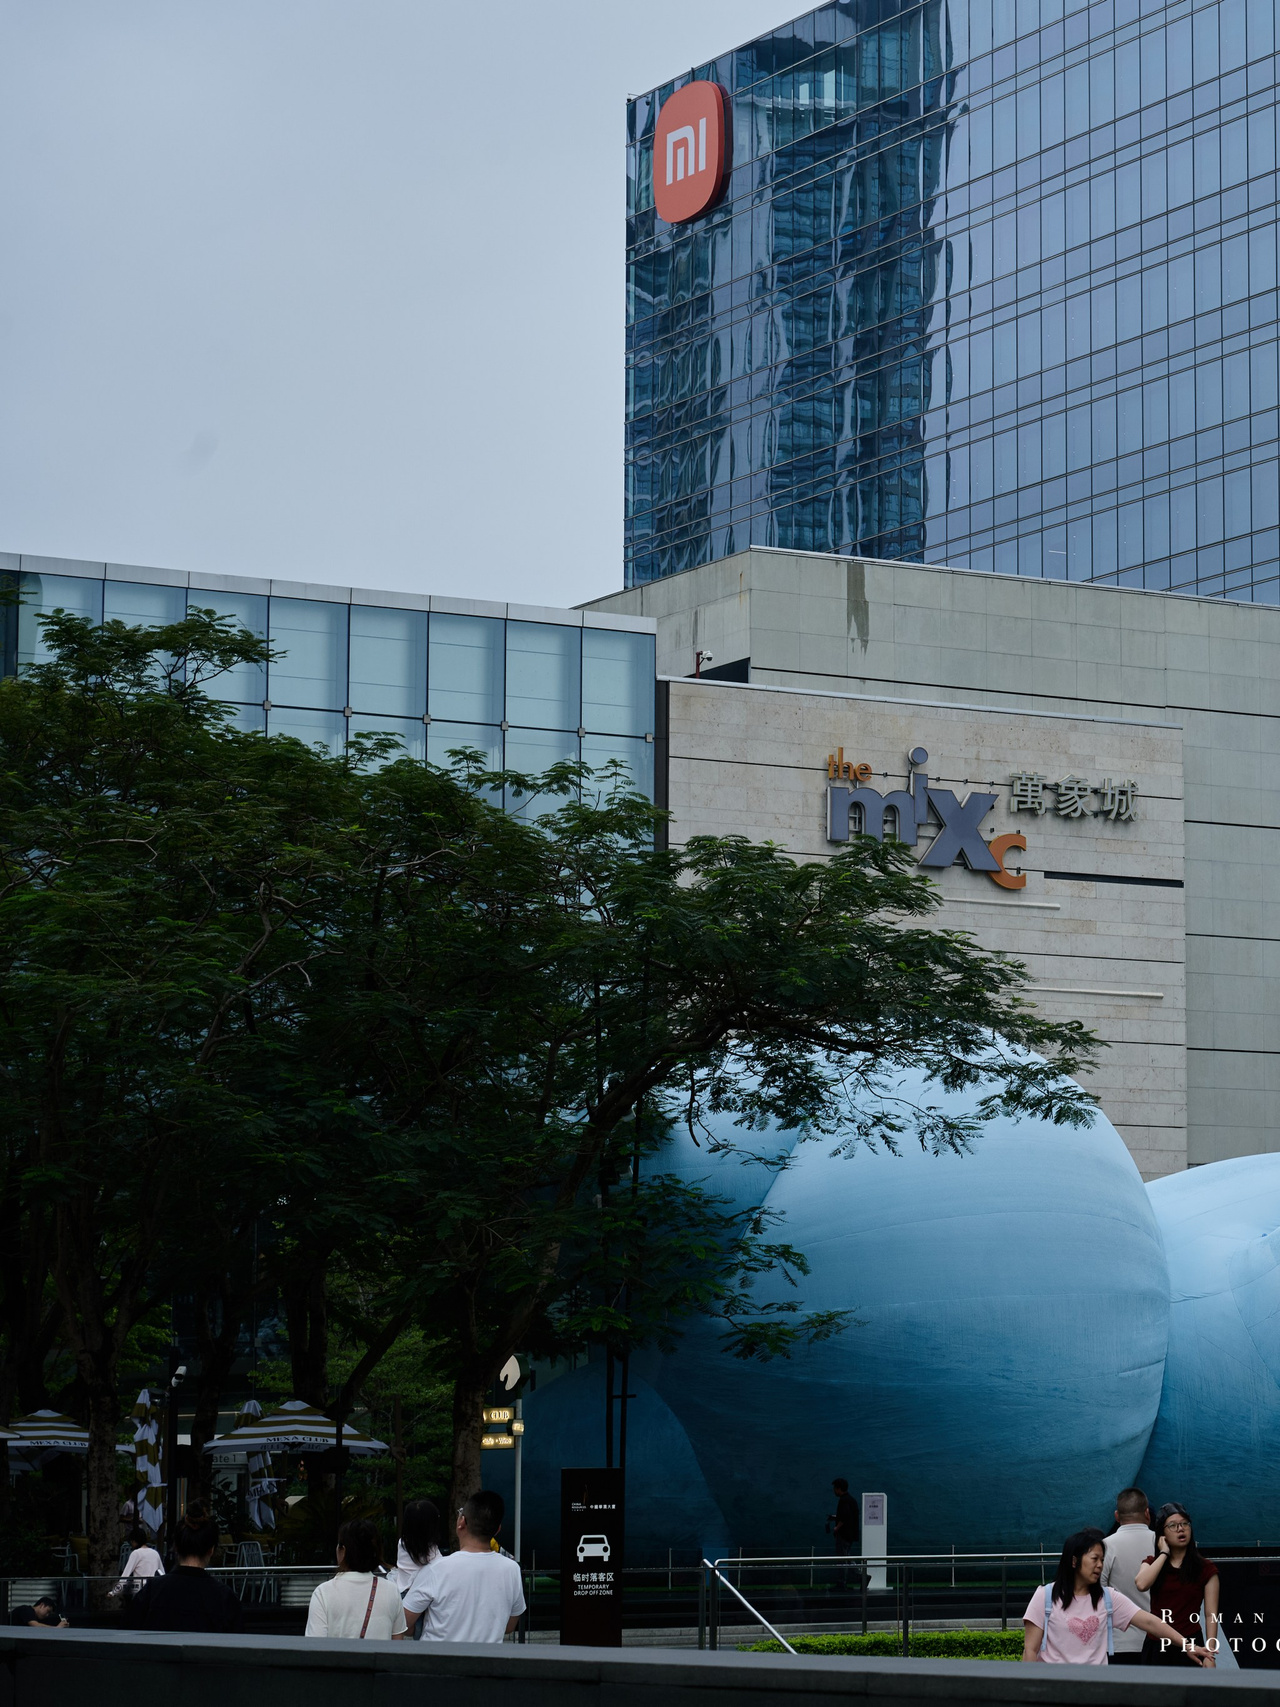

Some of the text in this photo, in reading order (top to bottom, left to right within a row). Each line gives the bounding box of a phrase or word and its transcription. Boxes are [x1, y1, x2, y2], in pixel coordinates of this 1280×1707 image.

[828, 747, 873, 782] the
[1009, 770, 1140, 822] 萬象城
[573, 1572, 615, 1582] 临时落客区
